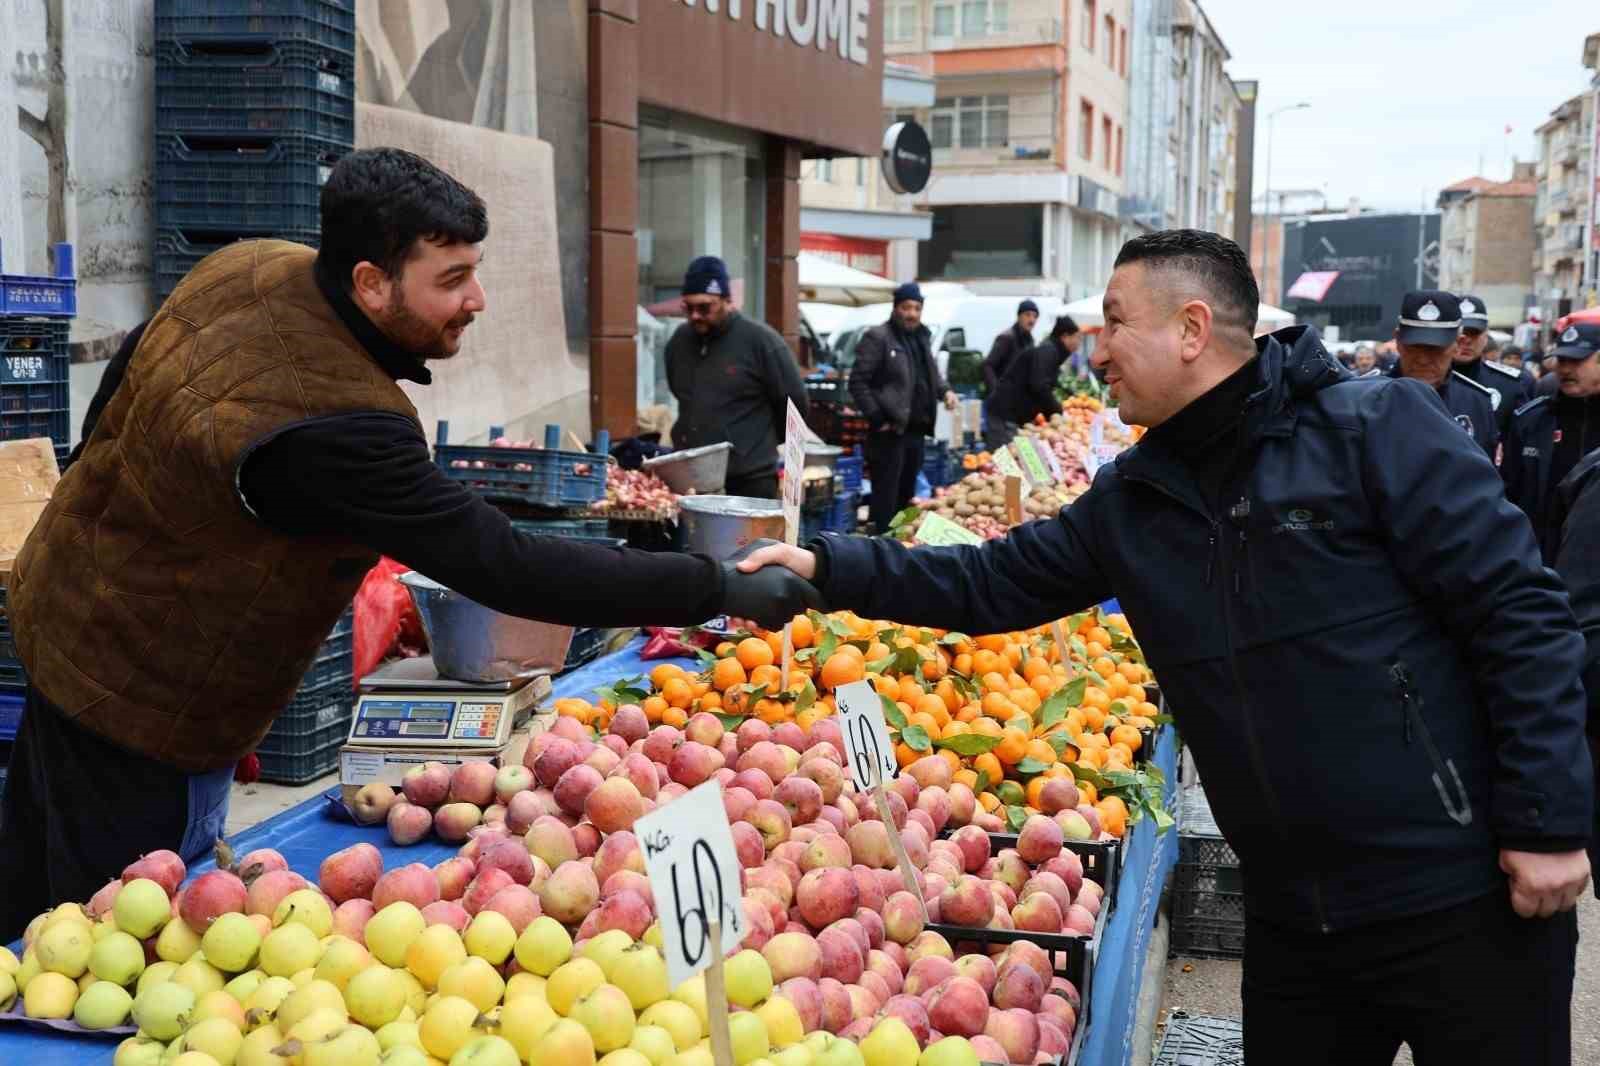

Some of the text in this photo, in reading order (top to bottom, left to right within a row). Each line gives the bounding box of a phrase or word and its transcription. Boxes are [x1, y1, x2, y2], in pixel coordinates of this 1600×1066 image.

[754, 0, 870, 65] HOME
[6, 356, 43, 370] YENER
[848, 713, 882, 787] 60
[671, 837, 724, 967] 60
